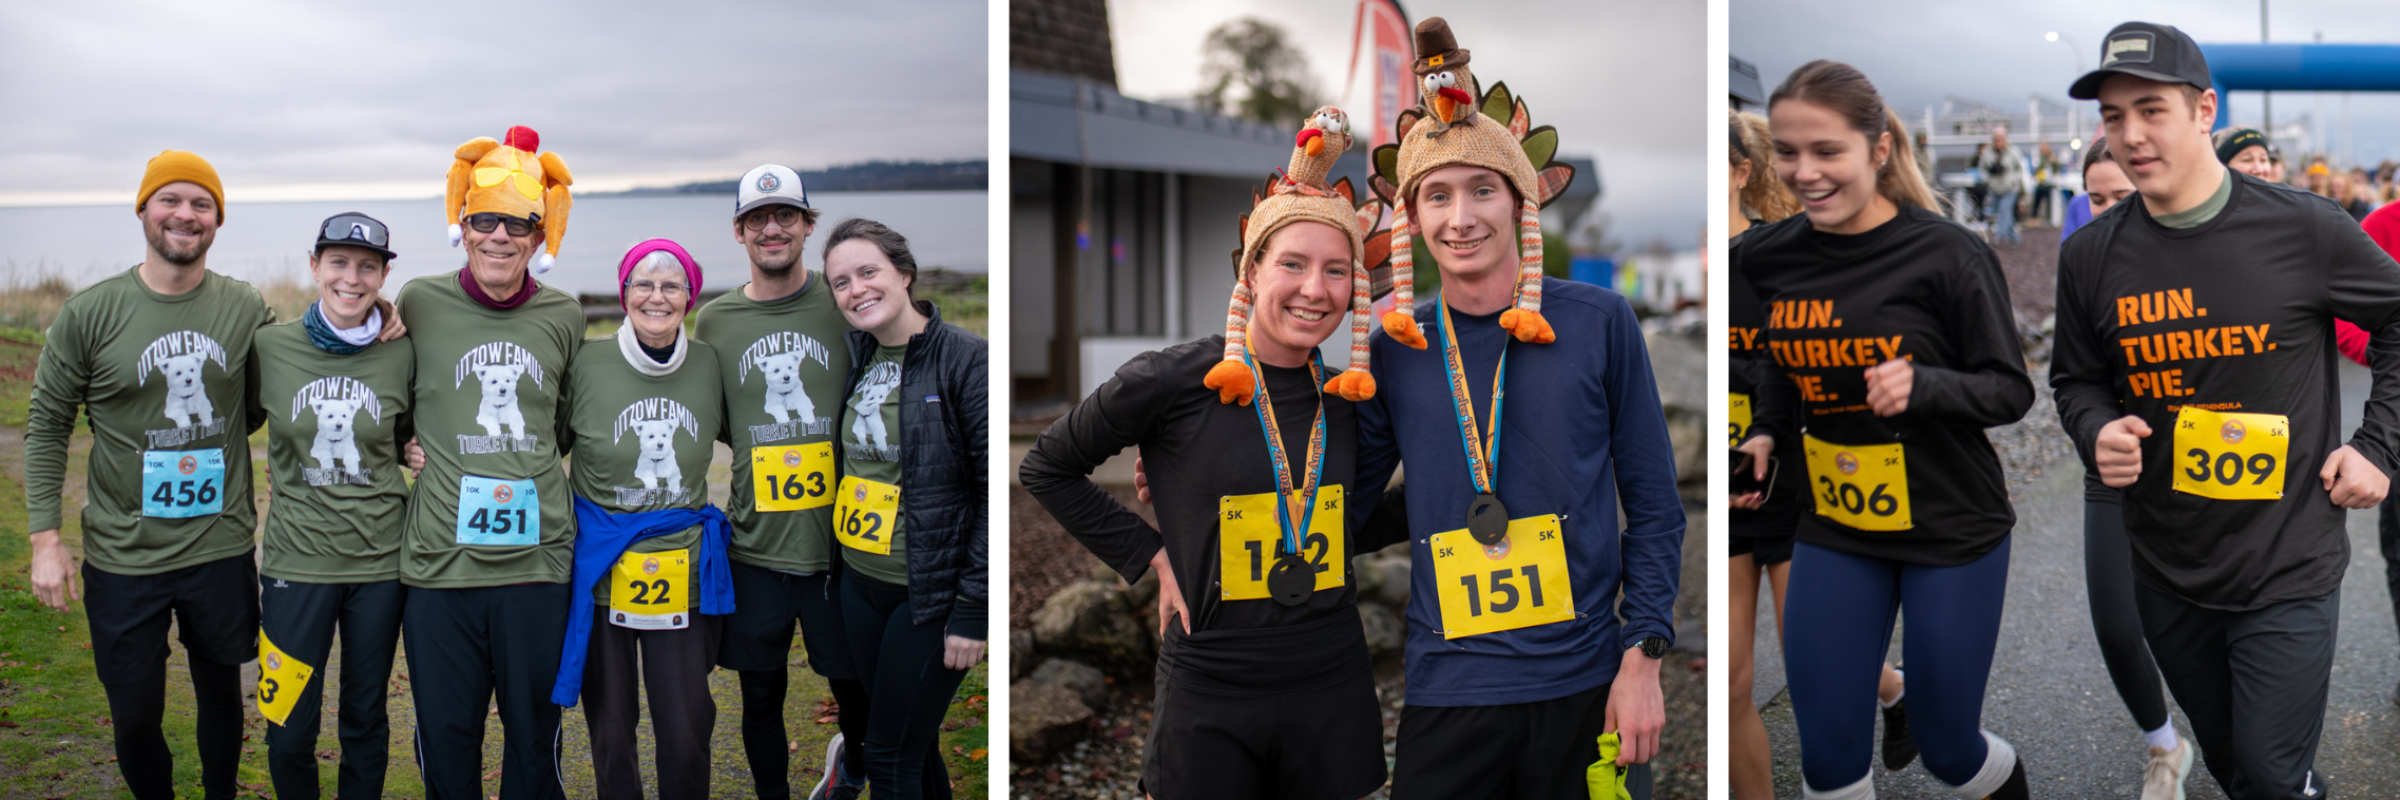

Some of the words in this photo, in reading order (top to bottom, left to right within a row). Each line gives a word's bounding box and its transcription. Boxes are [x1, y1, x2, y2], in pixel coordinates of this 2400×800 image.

[1768, 299, 1843, 329] RUN.
[2117, 288, 2208, 327] RUN.
[137, 331, 182, 388] LITZOW
[183, 330, 227, 373] FAMILY
[739, 332, 781, 386] LITZOW
[783, 331, 829, 371] FAMILY
[1446, 345, 1459, 371] Port
[1768, 335, 1913, 368] TURKEY.
[2119, 323, 2278, 367] TURKEY.
[455, 341, 504, 391] LITZOW
[505, 341, 544, 391] FAMILY
[1451, 372, 1469, 417] Angeles
[2127, 368, 2196, 399] PIE.
[291, 376, 342, 423] LITZOW
[342, 376, 382, 427] FAMILY
[1733, 399, 1746, 408] 5K
[614, 397, 659, 446] LITZOW
[660, 397, 699, 443] FAMILY
[748, 418, 798, 445] TURKEY
[798, 416, 832, 437] TROT
[1256, 393, 1279, 448] November
[2181, 420, 2195, 430] 5K
[2270, 428, 2285, 437] 5K
[145, 422, 198, 449] TURKEY
[456, 432, 509, 455] TURKEY
[1462, 416, 1478, 459] Turkey
[148, 461, 165, 469] 10K
[208, 458, 221, 466] 10K
[1273, 449, 1286, 466] 27,
[1308, 428, 1324, 473] Angeles
[1884, 457, 1899, 466] 5K
[1472, 458, 1485, 487] Trot
[2185, 447, 2277, 487] 309
[151, 478, 217, 508] 456
[466, 486, 480, 494] 10K
[614, 485, 664, 506] TURKEY
[766, 471, 827, 501] 163
[1277, 467, 1293, 497] 2025
[1303, 472, 1318, 497] Port
[1818, 475, 1899, 517] 306
[883, 494, 895, 502] 5K
[1324, 500, 1338, 510] 5K
[467, 507, 527, 535] 451
[839, 505, 883, 543] 162
[1226, 510, 1243, 520] 5K
[1539, 530, 1555, 541] 5K
[675, 558, 685, 566] 5K
[1439, 547, 1455, 558] 5K
[629, 578, 671, 605] 22
[1460, 564, 1545, 618] 151
[294, 672, 306, 681] 5K
